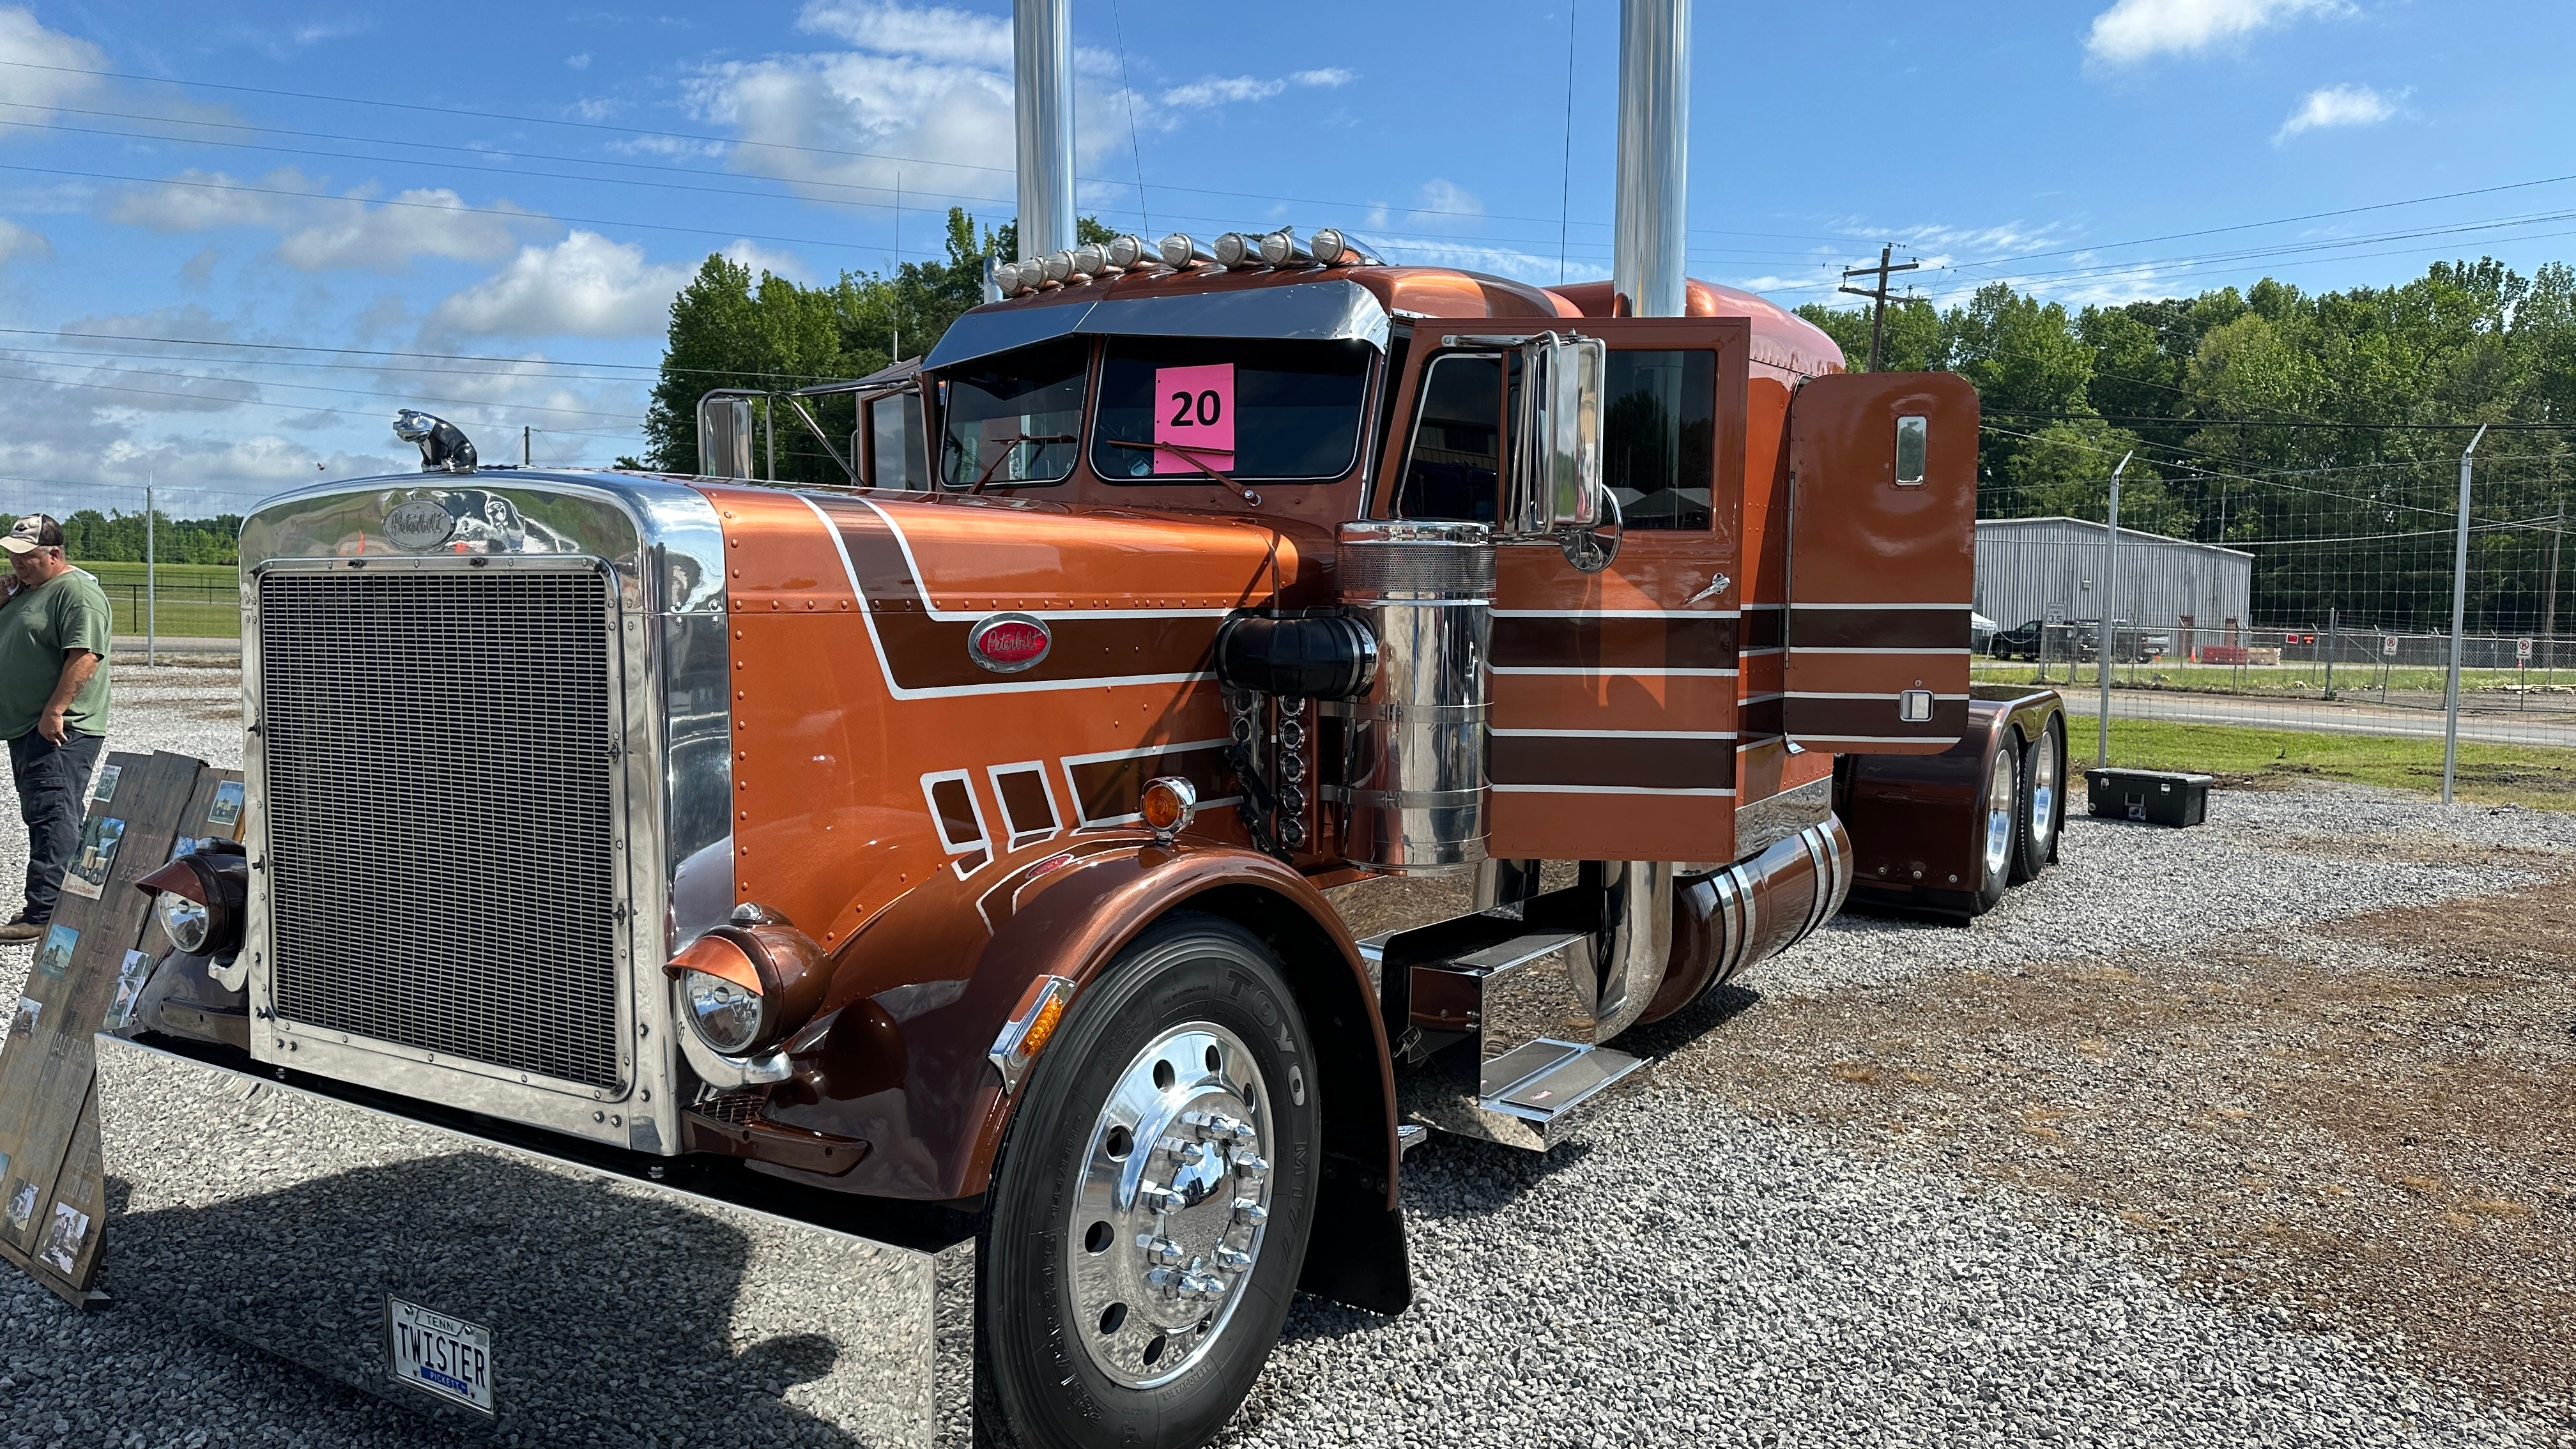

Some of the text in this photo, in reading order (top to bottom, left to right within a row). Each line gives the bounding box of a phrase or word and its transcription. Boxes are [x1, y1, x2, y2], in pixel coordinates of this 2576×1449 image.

[1170, 390, 1221, 427] 20
[391, 510, 447, 537] Peterbilt
[2048, 615, 2062, 624] 35
[986, 630, 1043, 654] Peterbilt
[1225, 969, 1306, 1107] TOYO
[1283, 1141, 1307, 1264] M177
[427, 1314, 454, 1331] TENN
[397, 1321, 486, 1388] TWISTER
[430, 1372, 459, 1390] PICKETT
